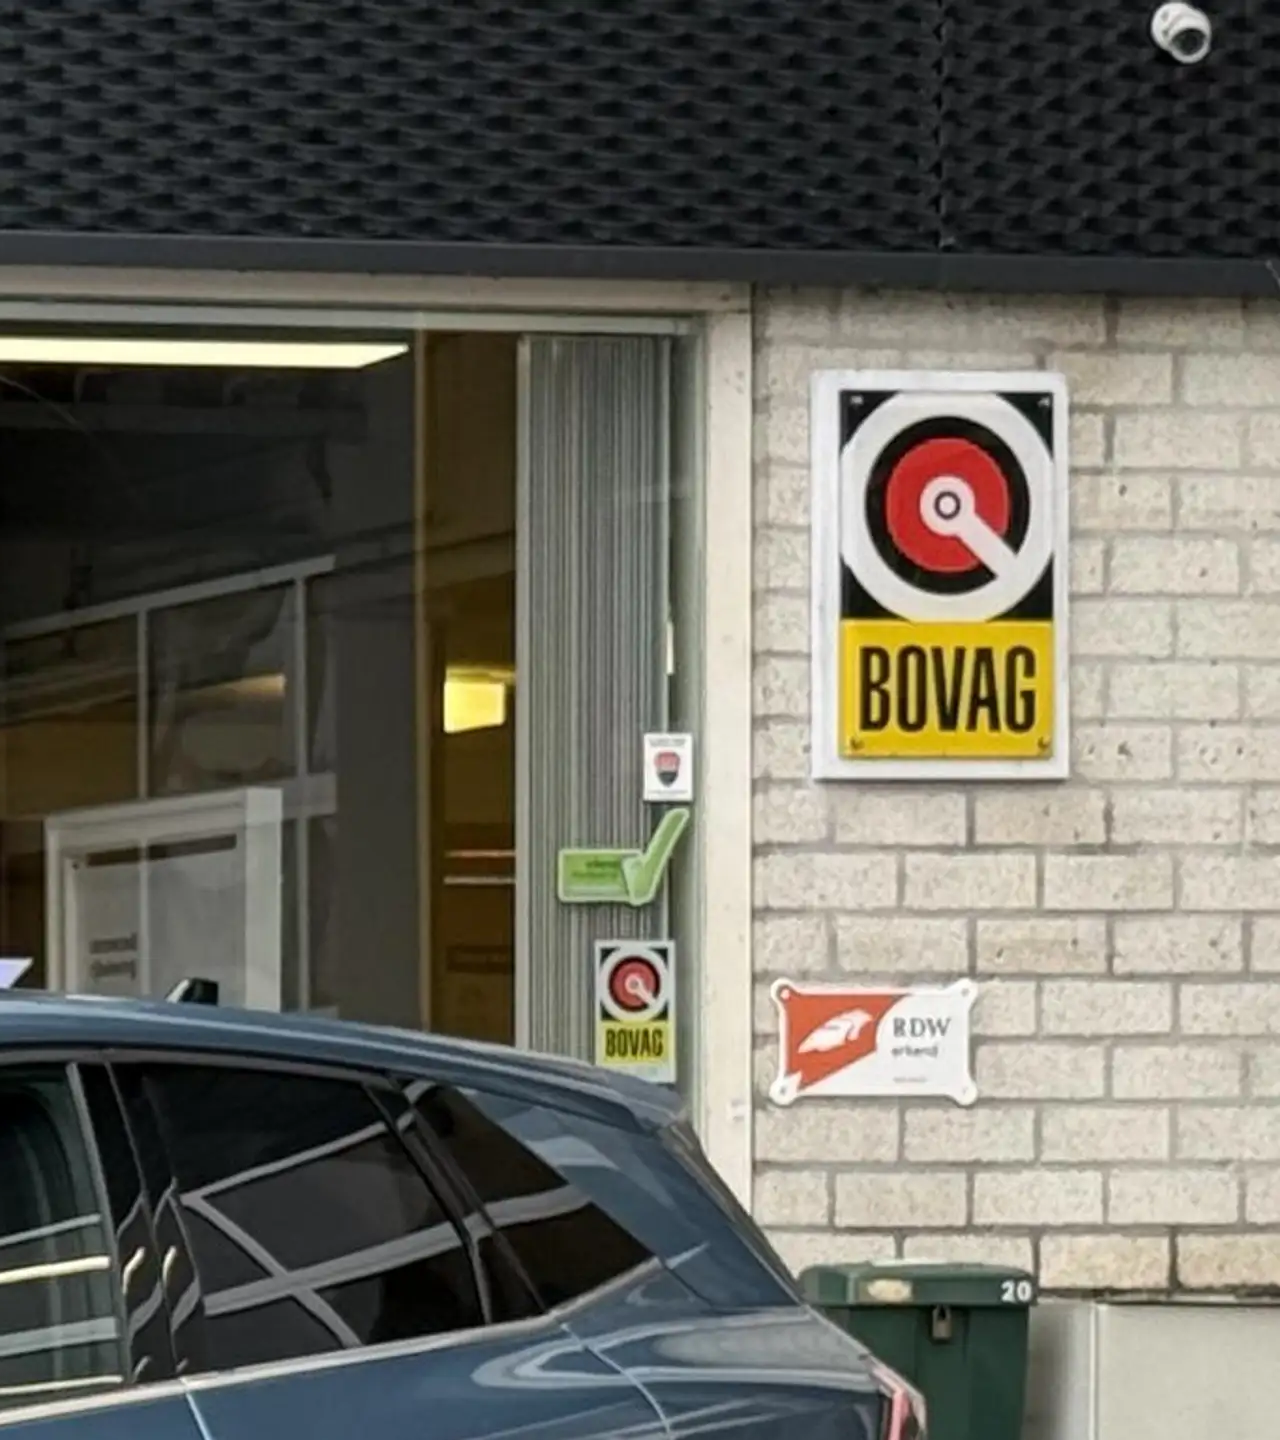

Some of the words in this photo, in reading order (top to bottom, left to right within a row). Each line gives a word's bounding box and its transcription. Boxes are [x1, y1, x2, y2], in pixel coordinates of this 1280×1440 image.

[860, 645, 1036, 733] BOVAG
[893, 1017, 952, 1037] RDW
[606, 1028, 664, 1057] BOVAG
[1001, 1280, 1032, 1302] 20
